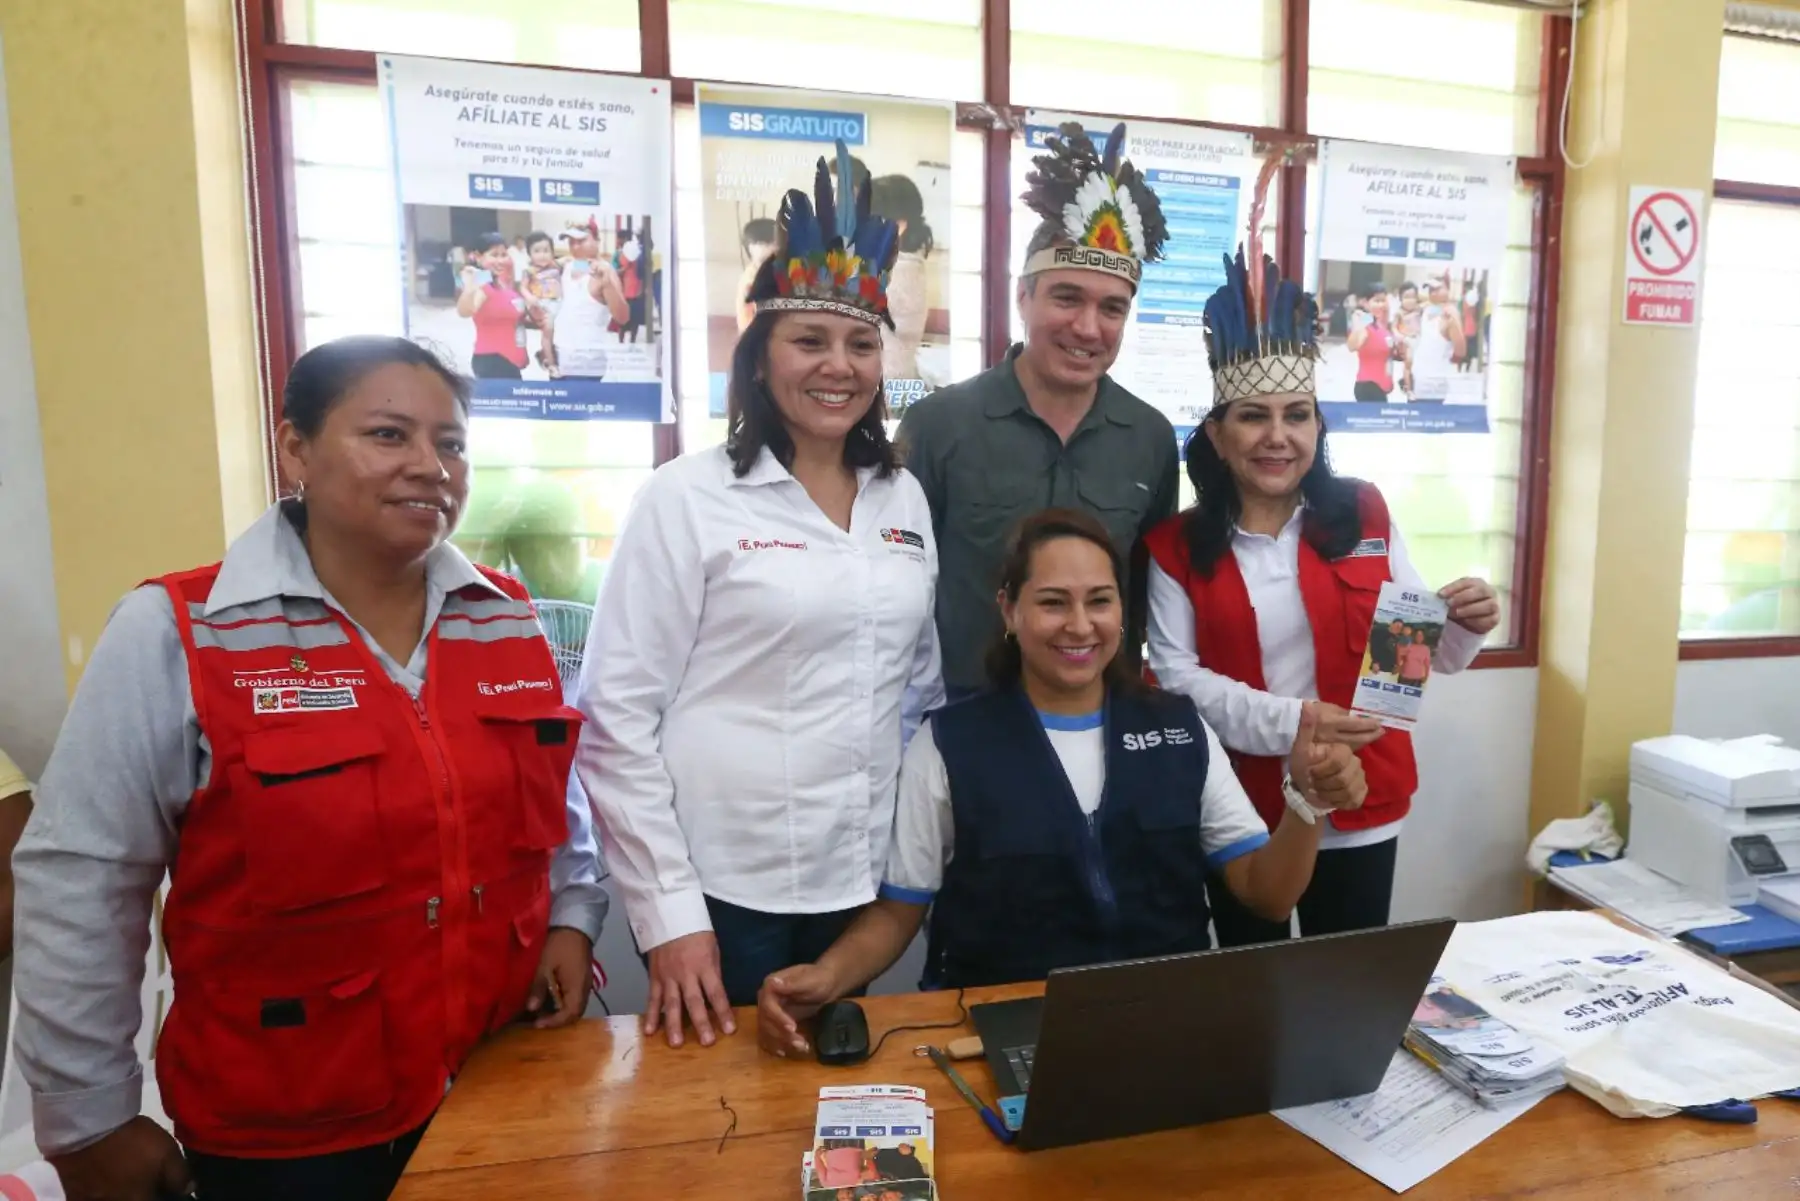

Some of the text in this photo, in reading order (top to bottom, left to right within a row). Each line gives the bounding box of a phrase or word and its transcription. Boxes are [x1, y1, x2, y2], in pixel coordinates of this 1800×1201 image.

[424, 84, 499, 103] Asegúrate
[503, 93, 554, 107] cuando
[558, 97, 594, 111] estés
[547, 113, 572, 131] AL
[578, 115, 608, 132] SIS
[729, 112, 860, 138] SISGRATUITO
[474, 177, 503, 192] SIS
[544, 181, 573, 196] SIS
[1639, 303, 1681, 320] FUMAR
[1401, 591, 1419, 603] SIS
[234, 677, 305, 687] Gobierno
[309, 678, 330, 687] del
[1122, 730, 1162, 751] SIS
[1564, 1003, 1598, 1019] SIS
[1508, 1056, 1533, 1068] SIS
